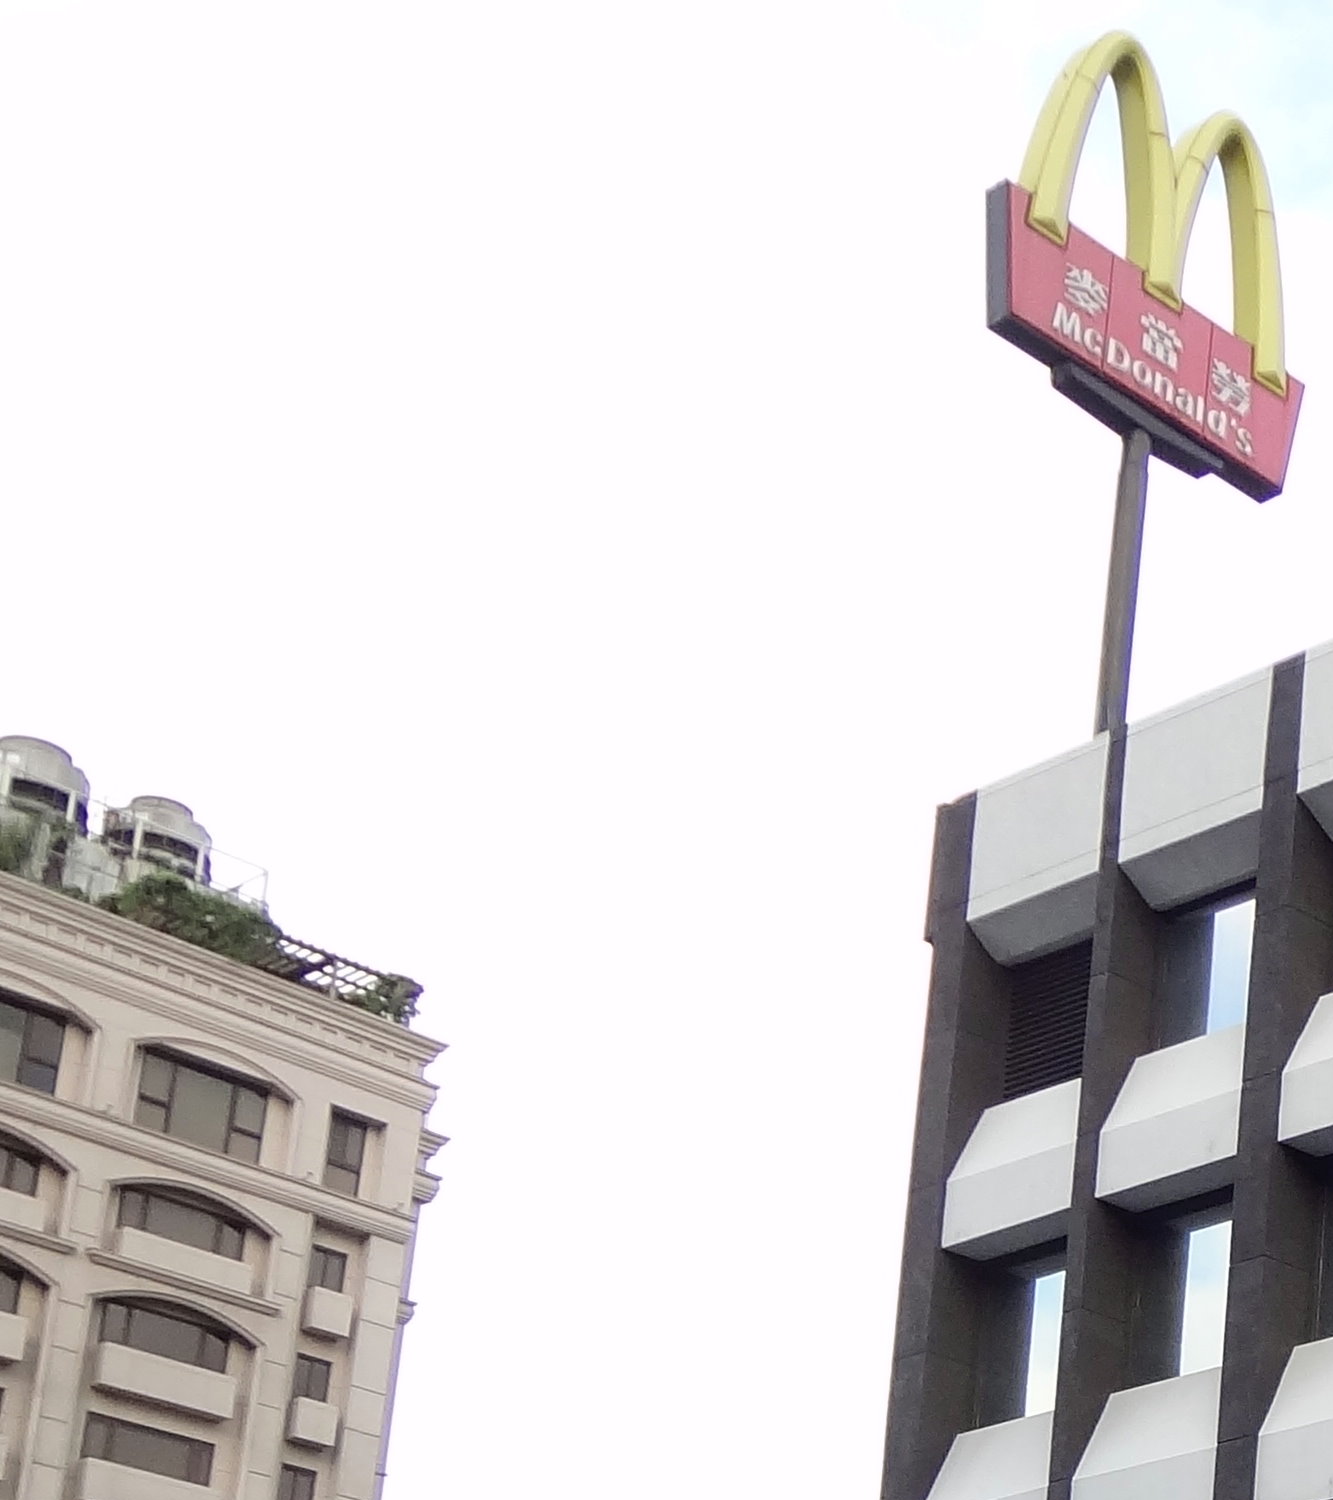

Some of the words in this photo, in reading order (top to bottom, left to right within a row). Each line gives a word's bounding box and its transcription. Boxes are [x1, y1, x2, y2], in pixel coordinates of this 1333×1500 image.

[1052, 302, 1253, 457] McDonald's
[1064, 262, 1251, 416] 麥當勞
